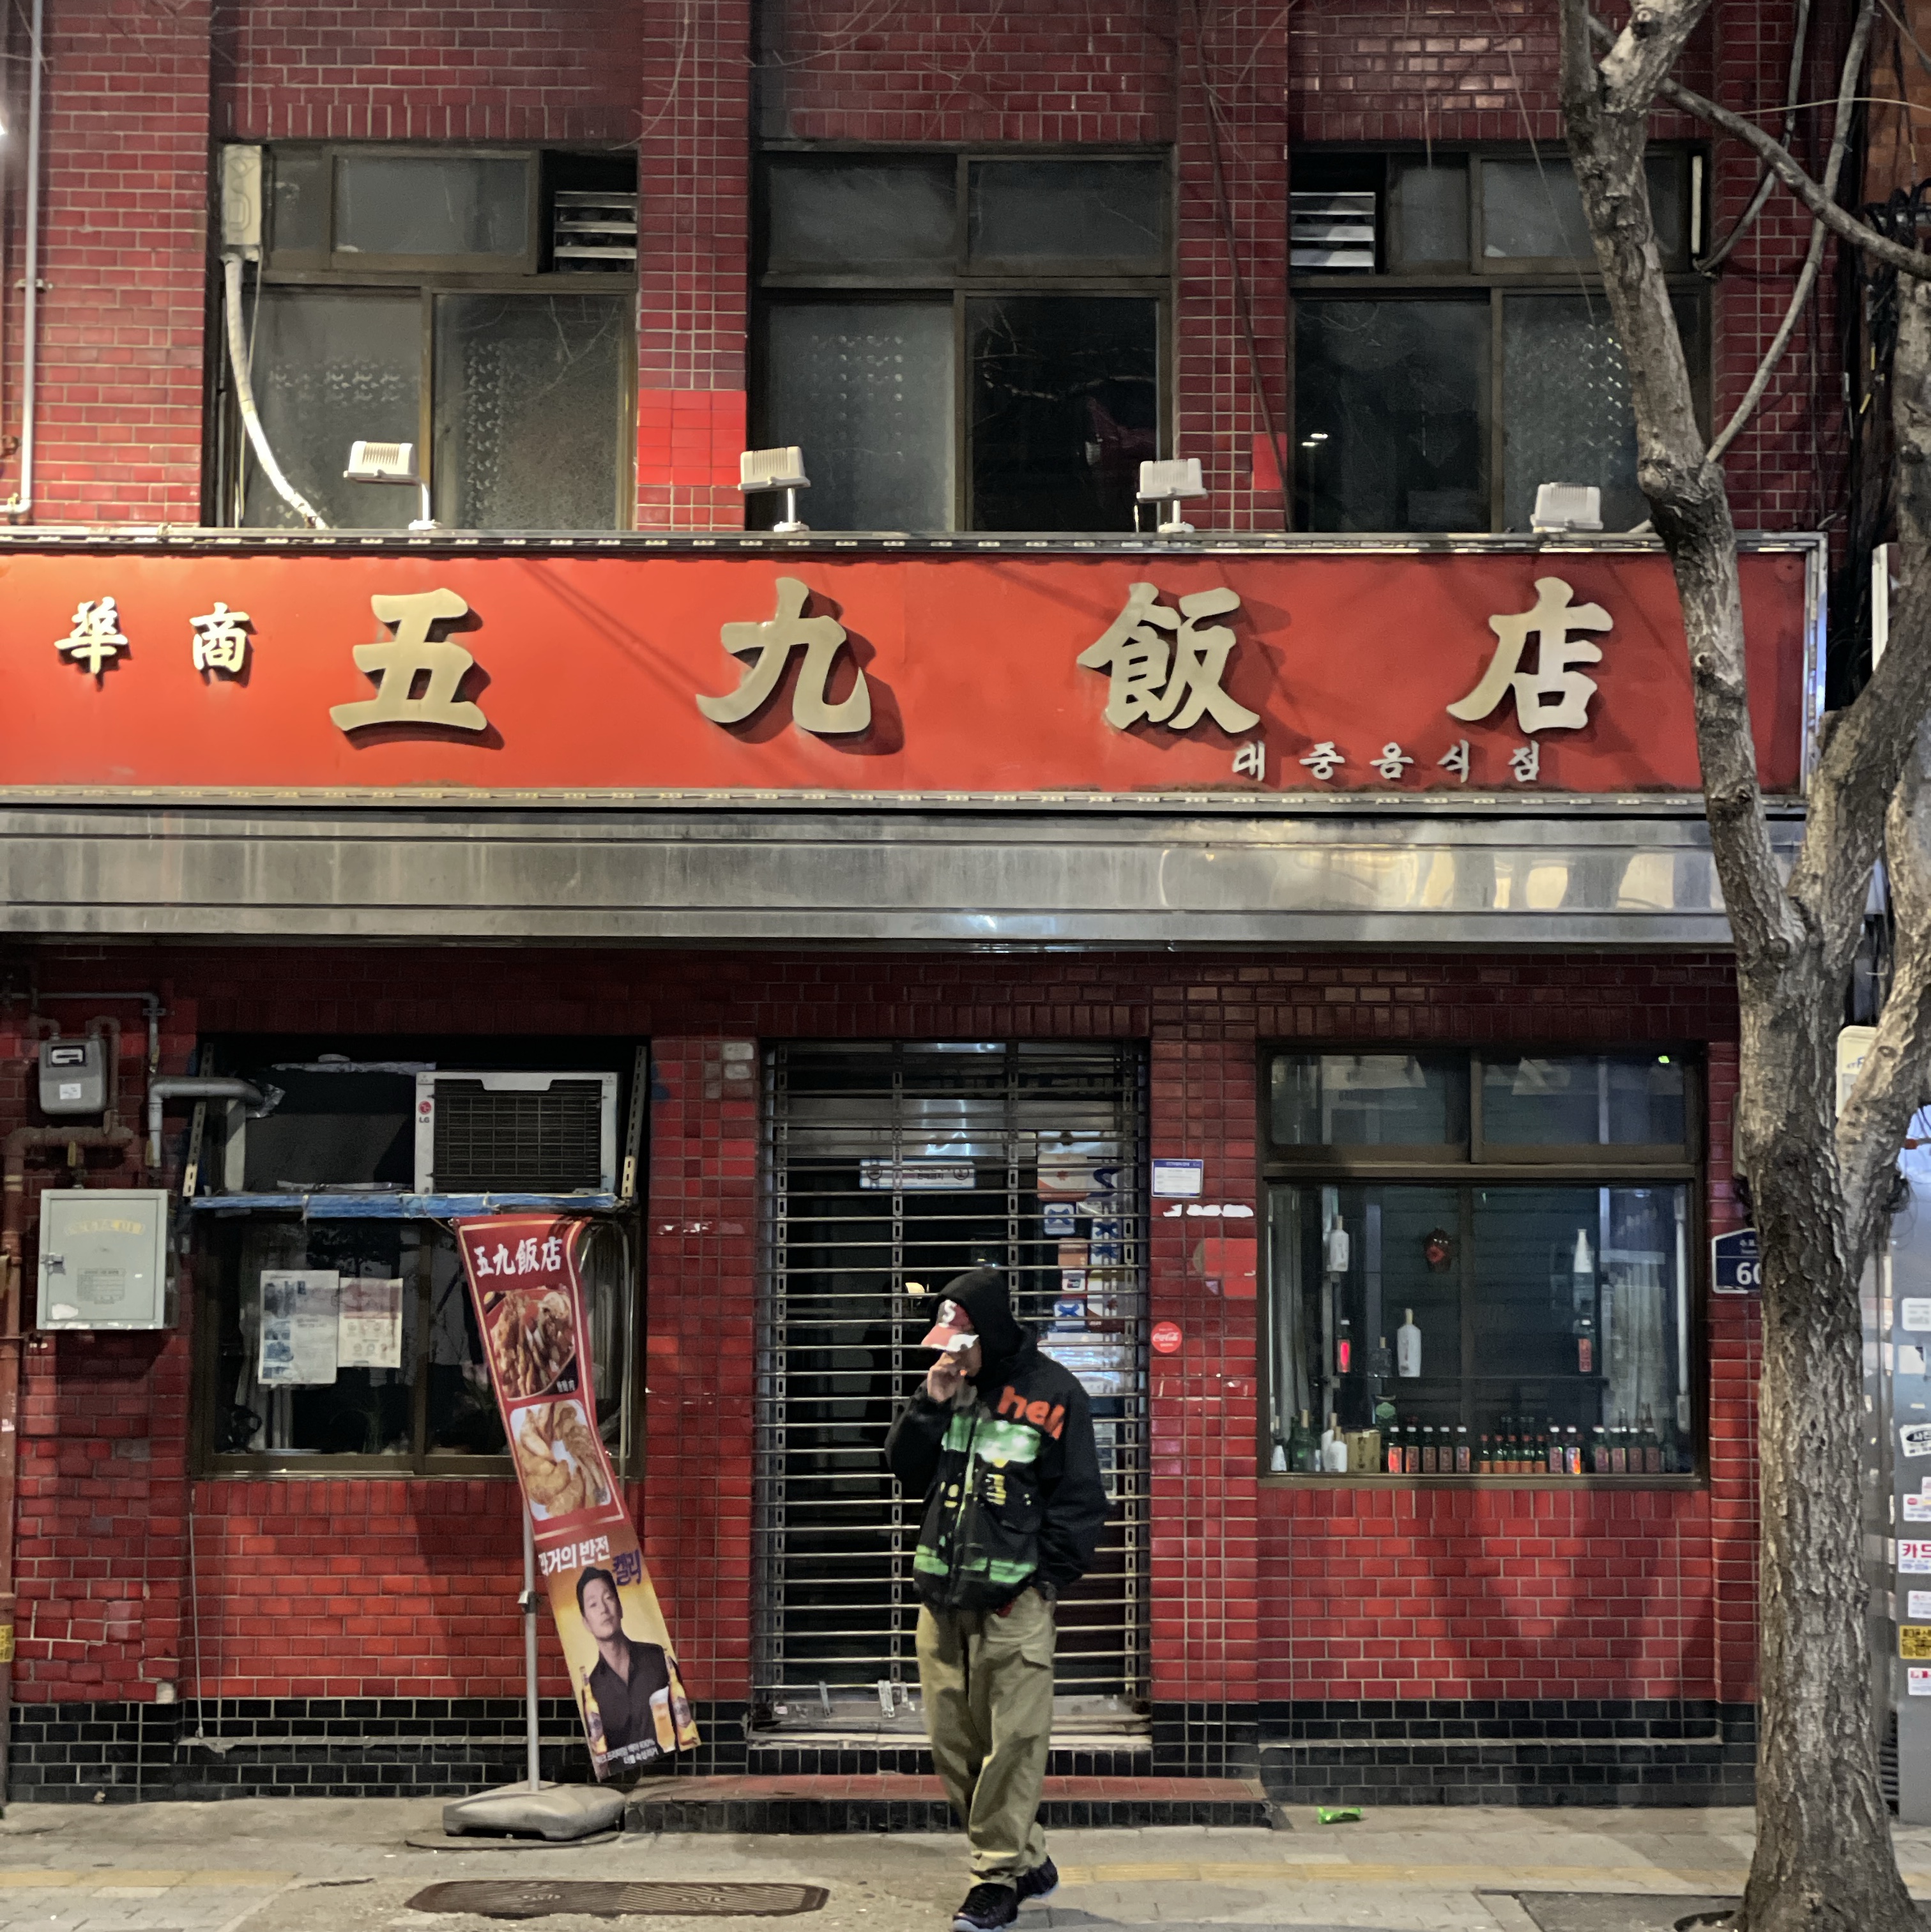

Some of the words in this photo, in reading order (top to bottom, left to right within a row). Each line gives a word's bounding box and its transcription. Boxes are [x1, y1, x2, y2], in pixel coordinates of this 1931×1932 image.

[54, 597, 250, 674] 華商
[329, 577, 1614, 734] 五九飯店
[1232, 741, 1541, 783] 대중음식점
[473, 1236, 562, 1277] 五九飯店
[942, 1299, 958, 1323] S
[579, 1535, 610, 1566] 반전
